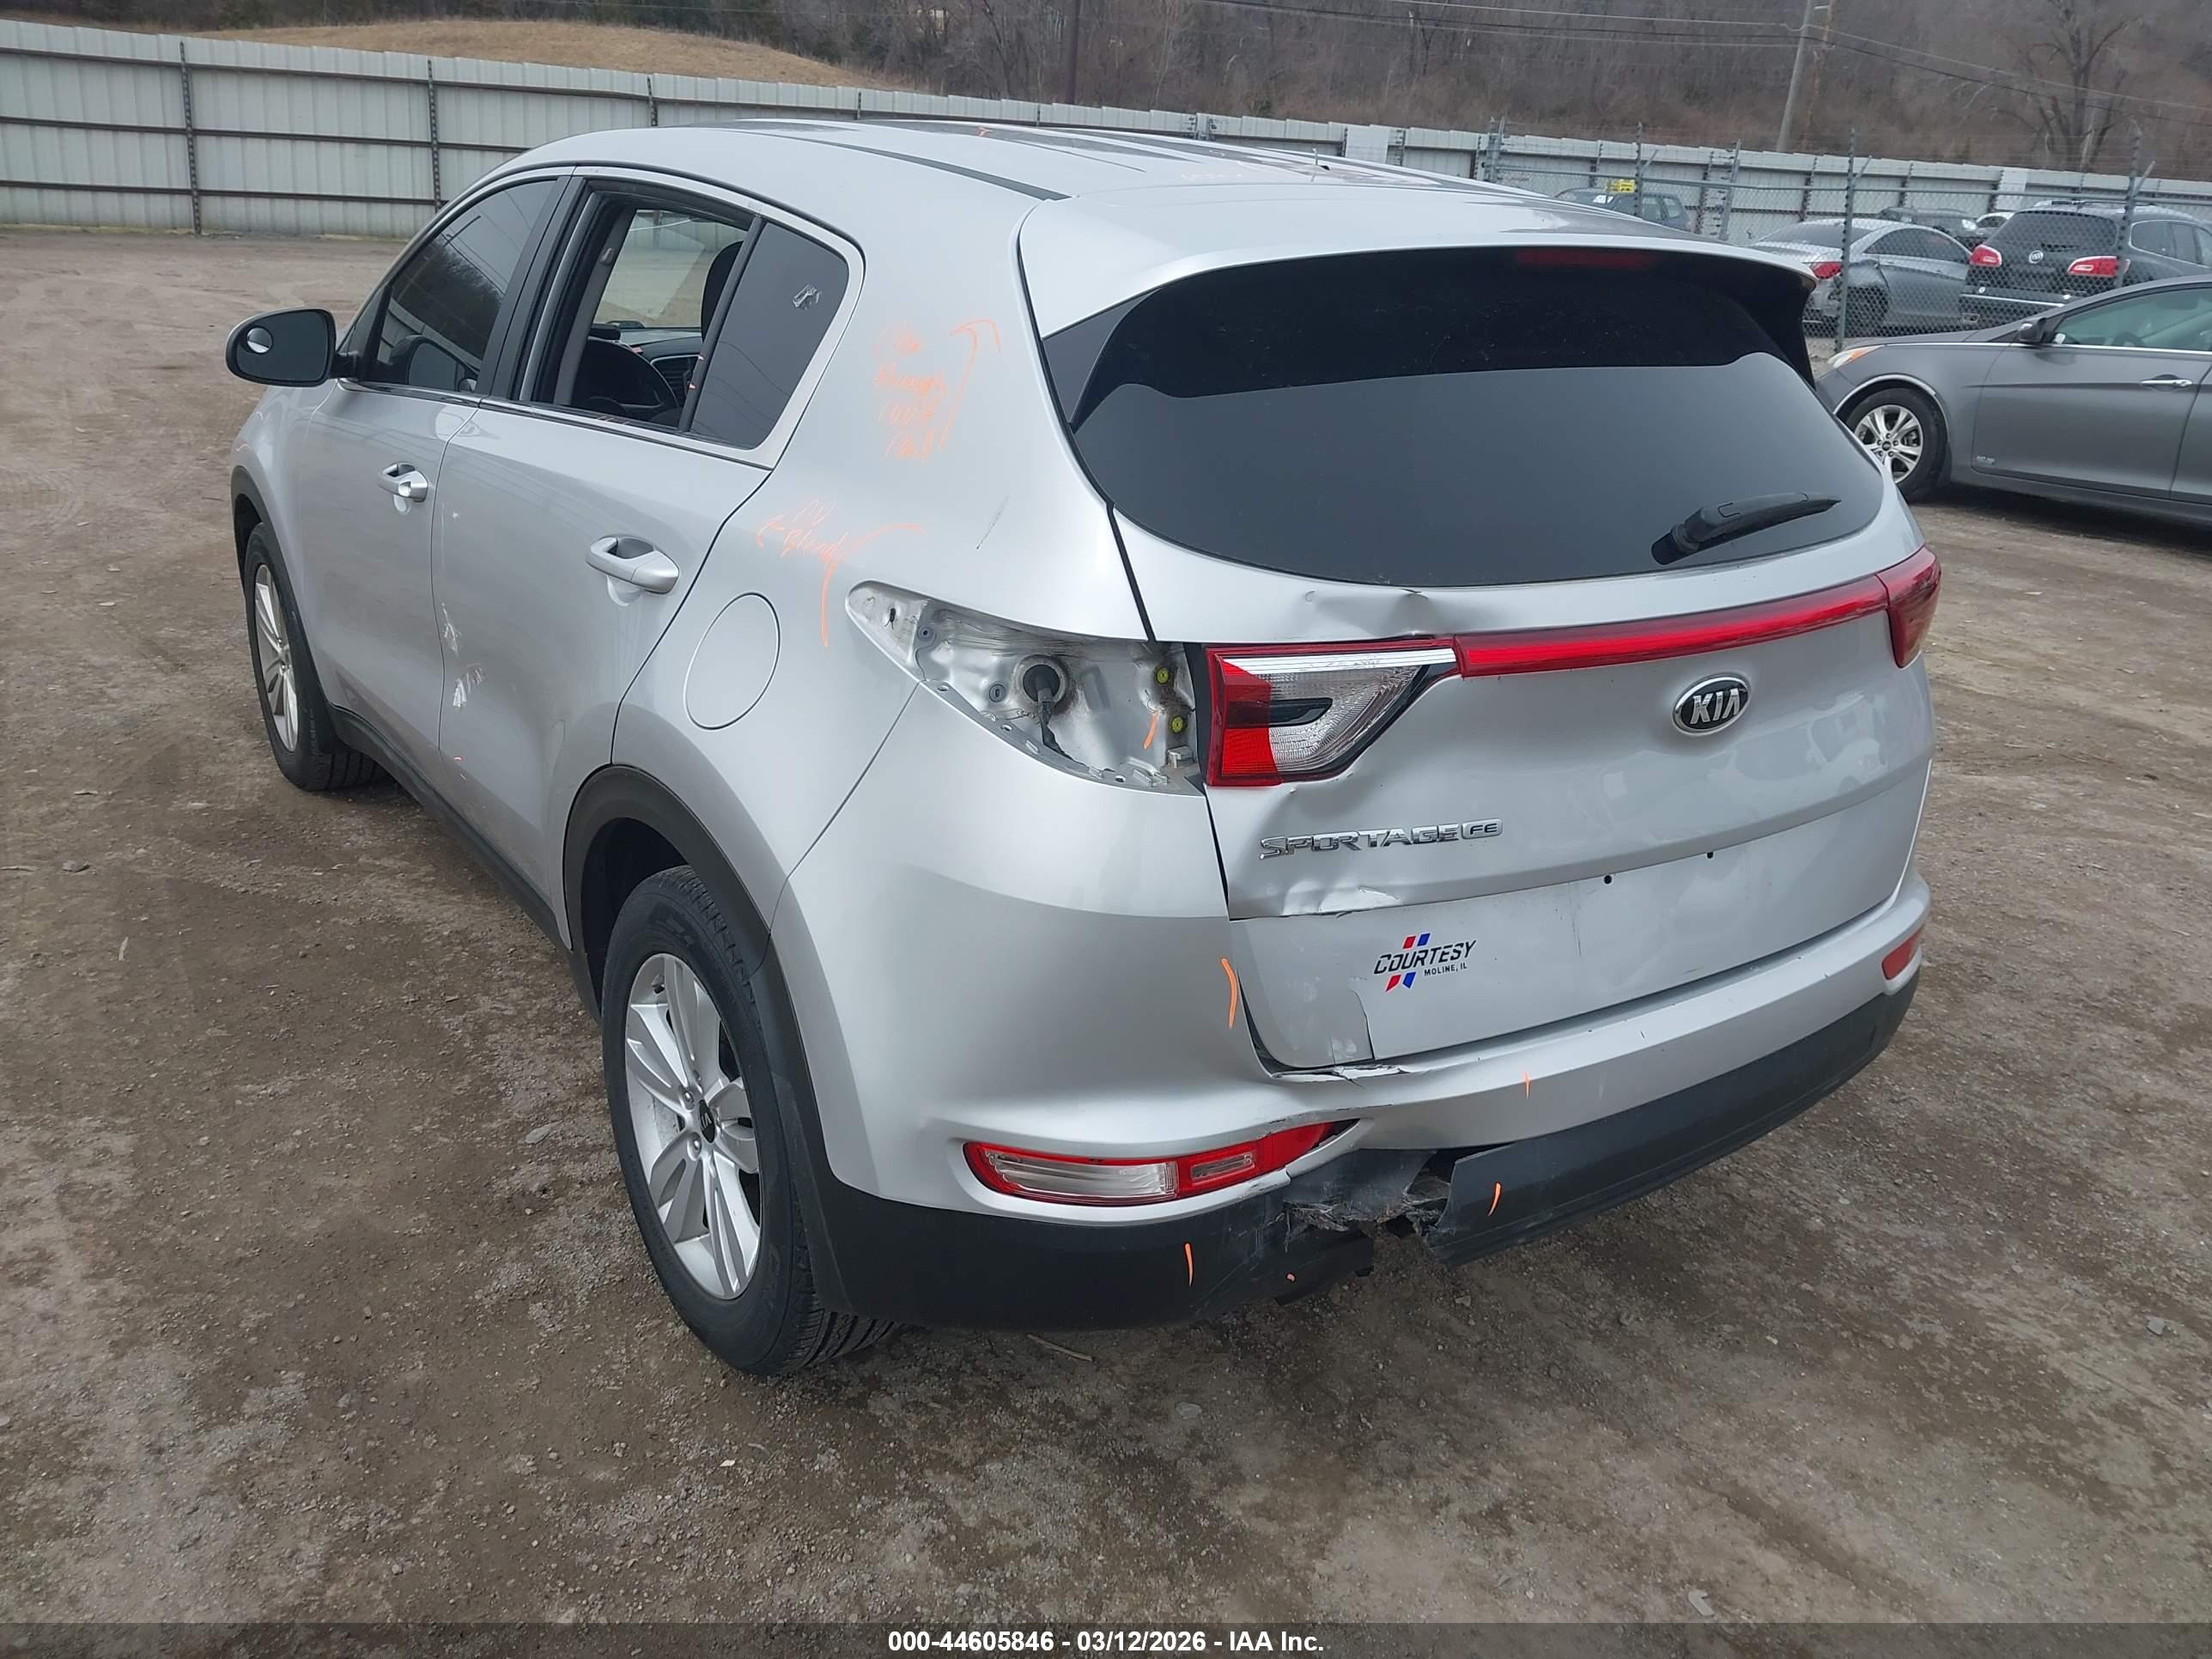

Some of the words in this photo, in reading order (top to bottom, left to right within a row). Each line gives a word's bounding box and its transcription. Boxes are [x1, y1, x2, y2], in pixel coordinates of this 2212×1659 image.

[1689, 688, 1741, 724] KIA
[1259, 823, 1460, 860] SPORTAGE
[1469, 822, 1498, 836] FE
[1373, 939, 1478, 975] COURTESY
[1425, 964, 1458, 975] MOLINE,
